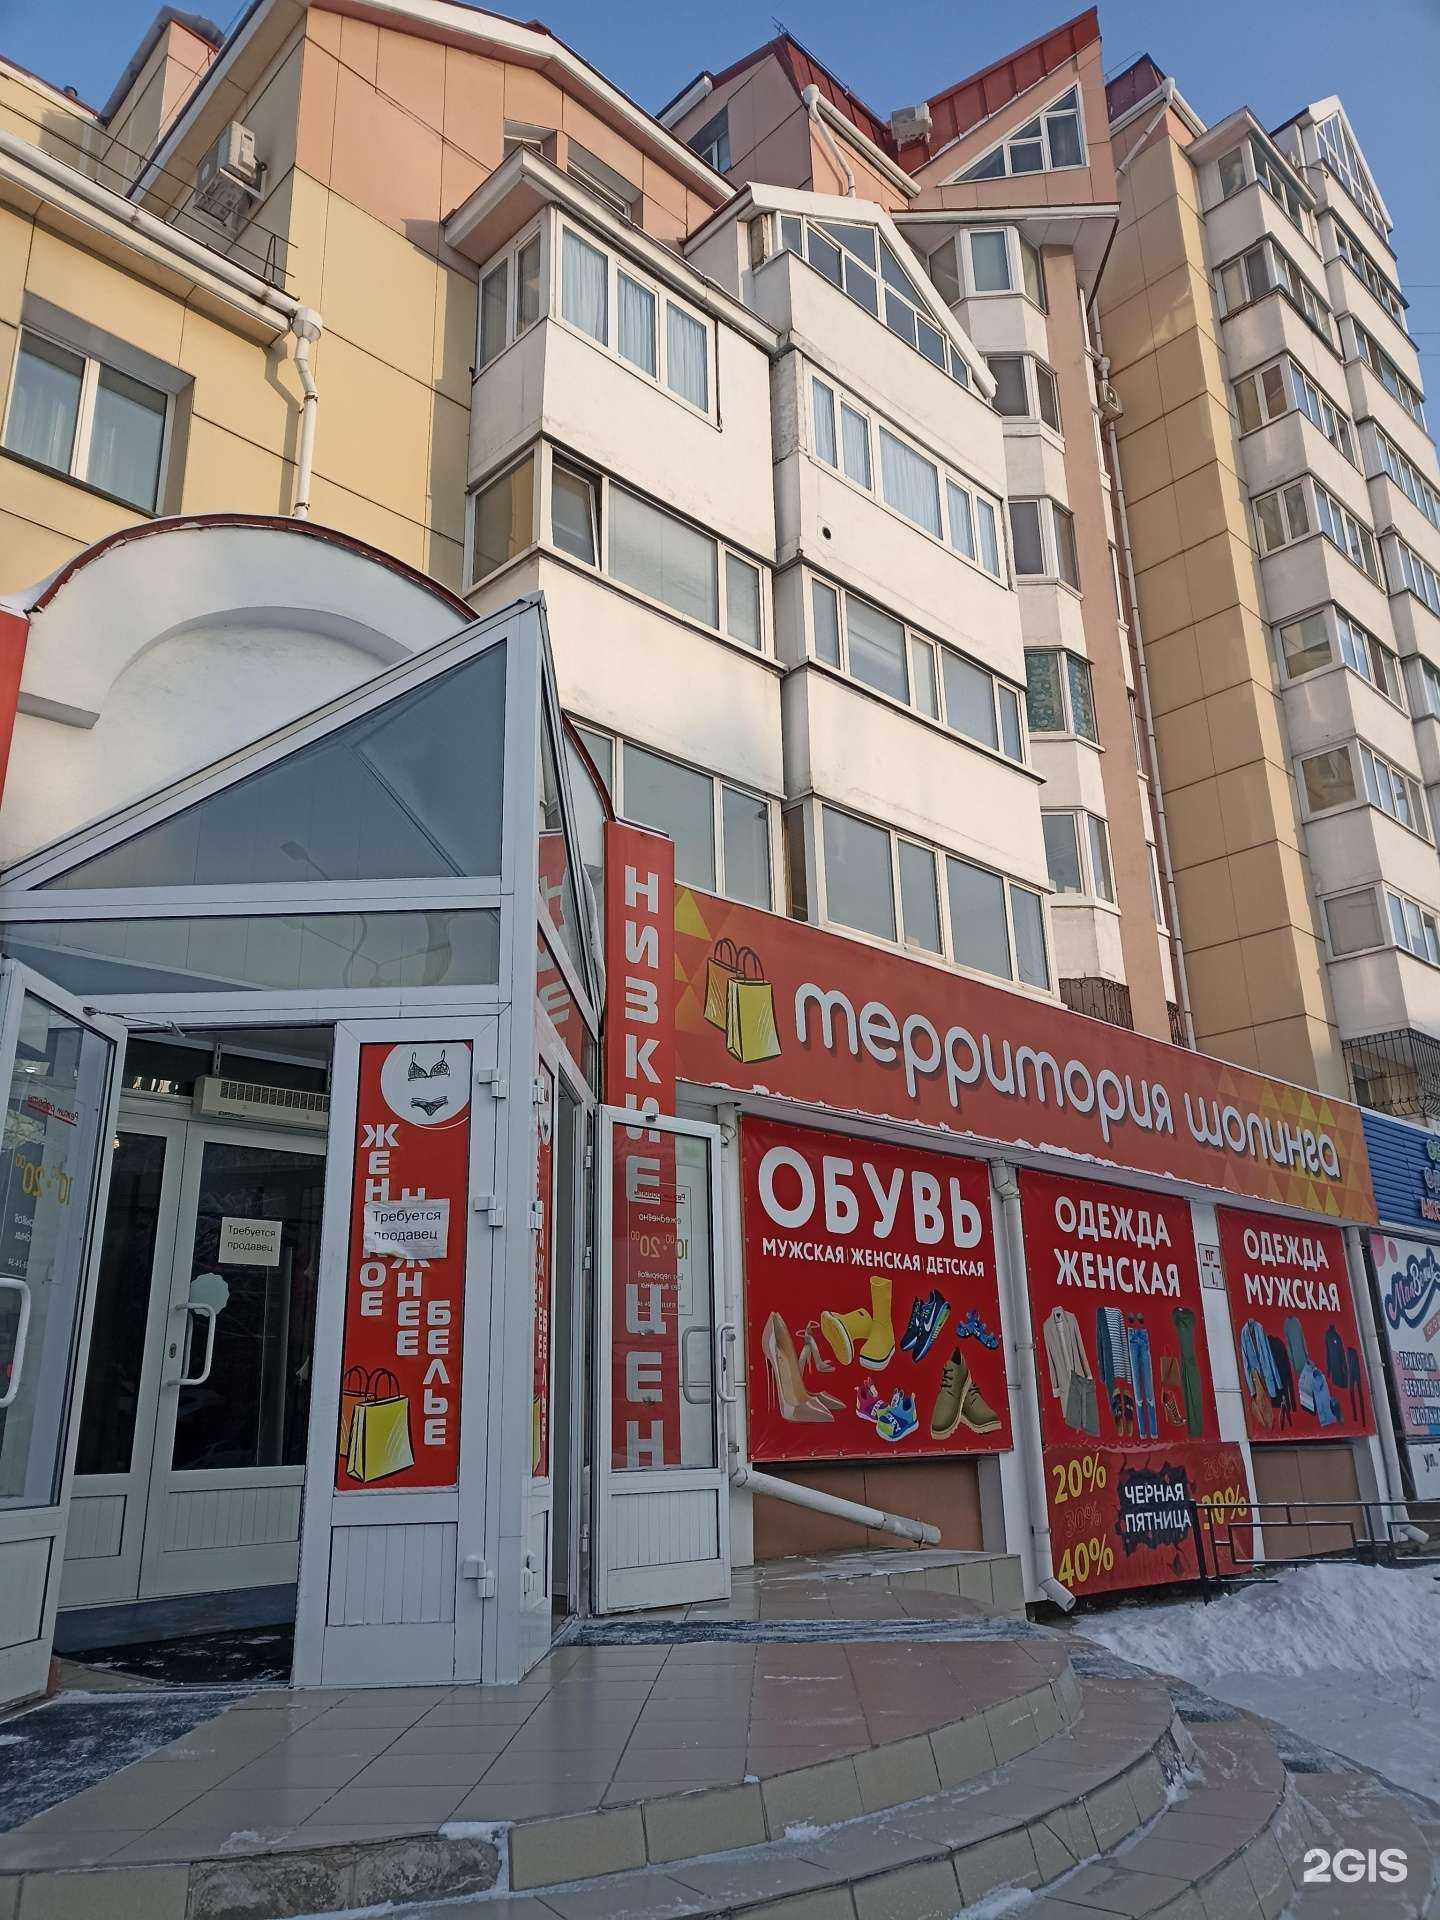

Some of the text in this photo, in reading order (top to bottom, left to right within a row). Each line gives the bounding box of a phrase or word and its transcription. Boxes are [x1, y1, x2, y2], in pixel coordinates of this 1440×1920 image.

[795, 983, 1342, 1179] территория шопинга
[373, 1210, 441, 1224] Требуется
[758, 1145, 984, 1249] ОБУВЬ
[228, 1224, 276, 1238] Требуется
[1054, 1195, 1172, 1250] ОДЕЖДА
[227, 1240, 273, 1252] продавец
[762, 1237, 985, 1278] МУЖСКАЯ ЖЕНСКАЯ ДЕТСКАЯ
[1243, 1228, 1329, 1270] ОДЕЖДА
[1054, 1248, 1181, 1298] ЖЕНСКАЯ
[1244, 1274, 1341, 1312] МУЖСКАЯ
[423, 1300, 451, 1446] БЕЛЬЕ
[1053, 1452, 1107, 1505] 20%
[1124, 1483, 1185, 1504] ЧЕРНАЯ
[1125, 1510, 1192, 1533] ПЯТНИЦА
[1058, 1534, 1114, 1588] 40%
